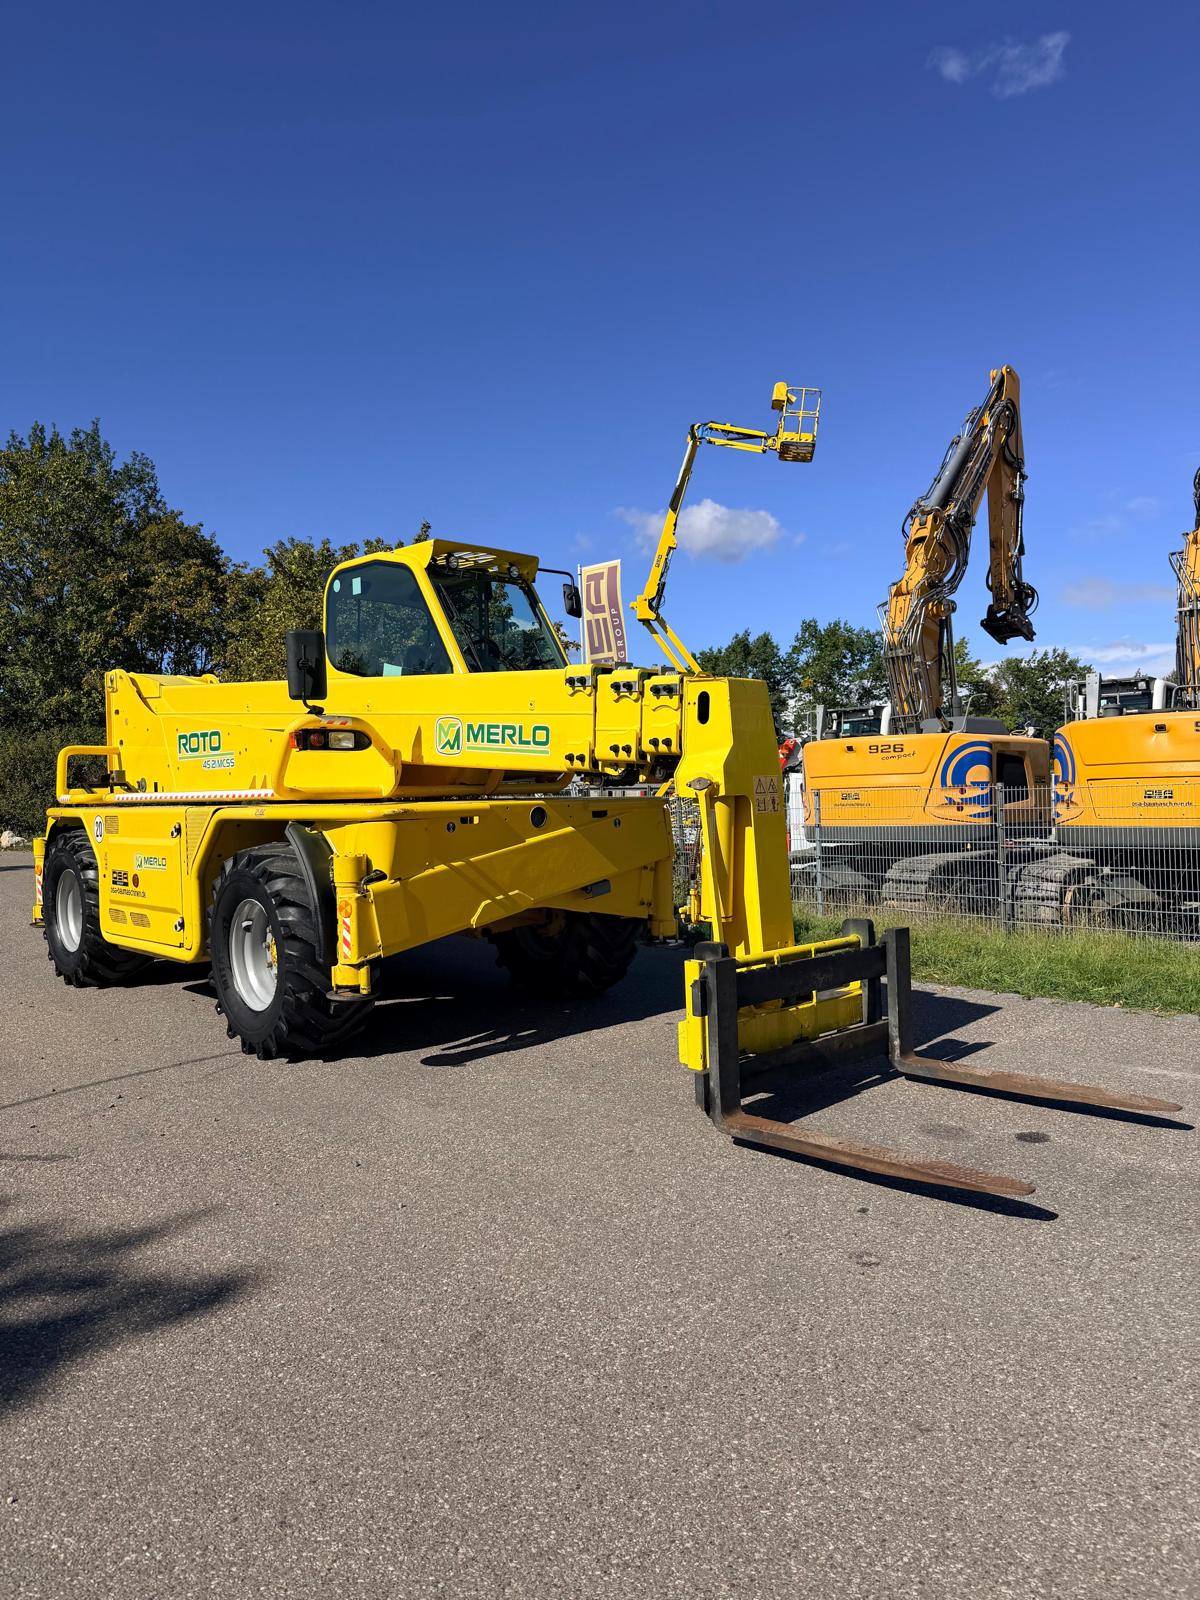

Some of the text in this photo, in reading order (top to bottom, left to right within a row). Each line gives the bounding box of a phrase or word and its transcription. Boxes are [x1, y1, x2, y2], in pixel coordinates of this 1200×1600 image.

[611, 608, 625, 658] GROUP
[178, 731, 221, 754] ROTO
[466, 723, 550, 746] MERLO
[868, 744, 904, 754] 926
[881, 751, 916, 761] compact
[95, 821, 103, 838] 20
[143, 856, 167, 867] MERLO
